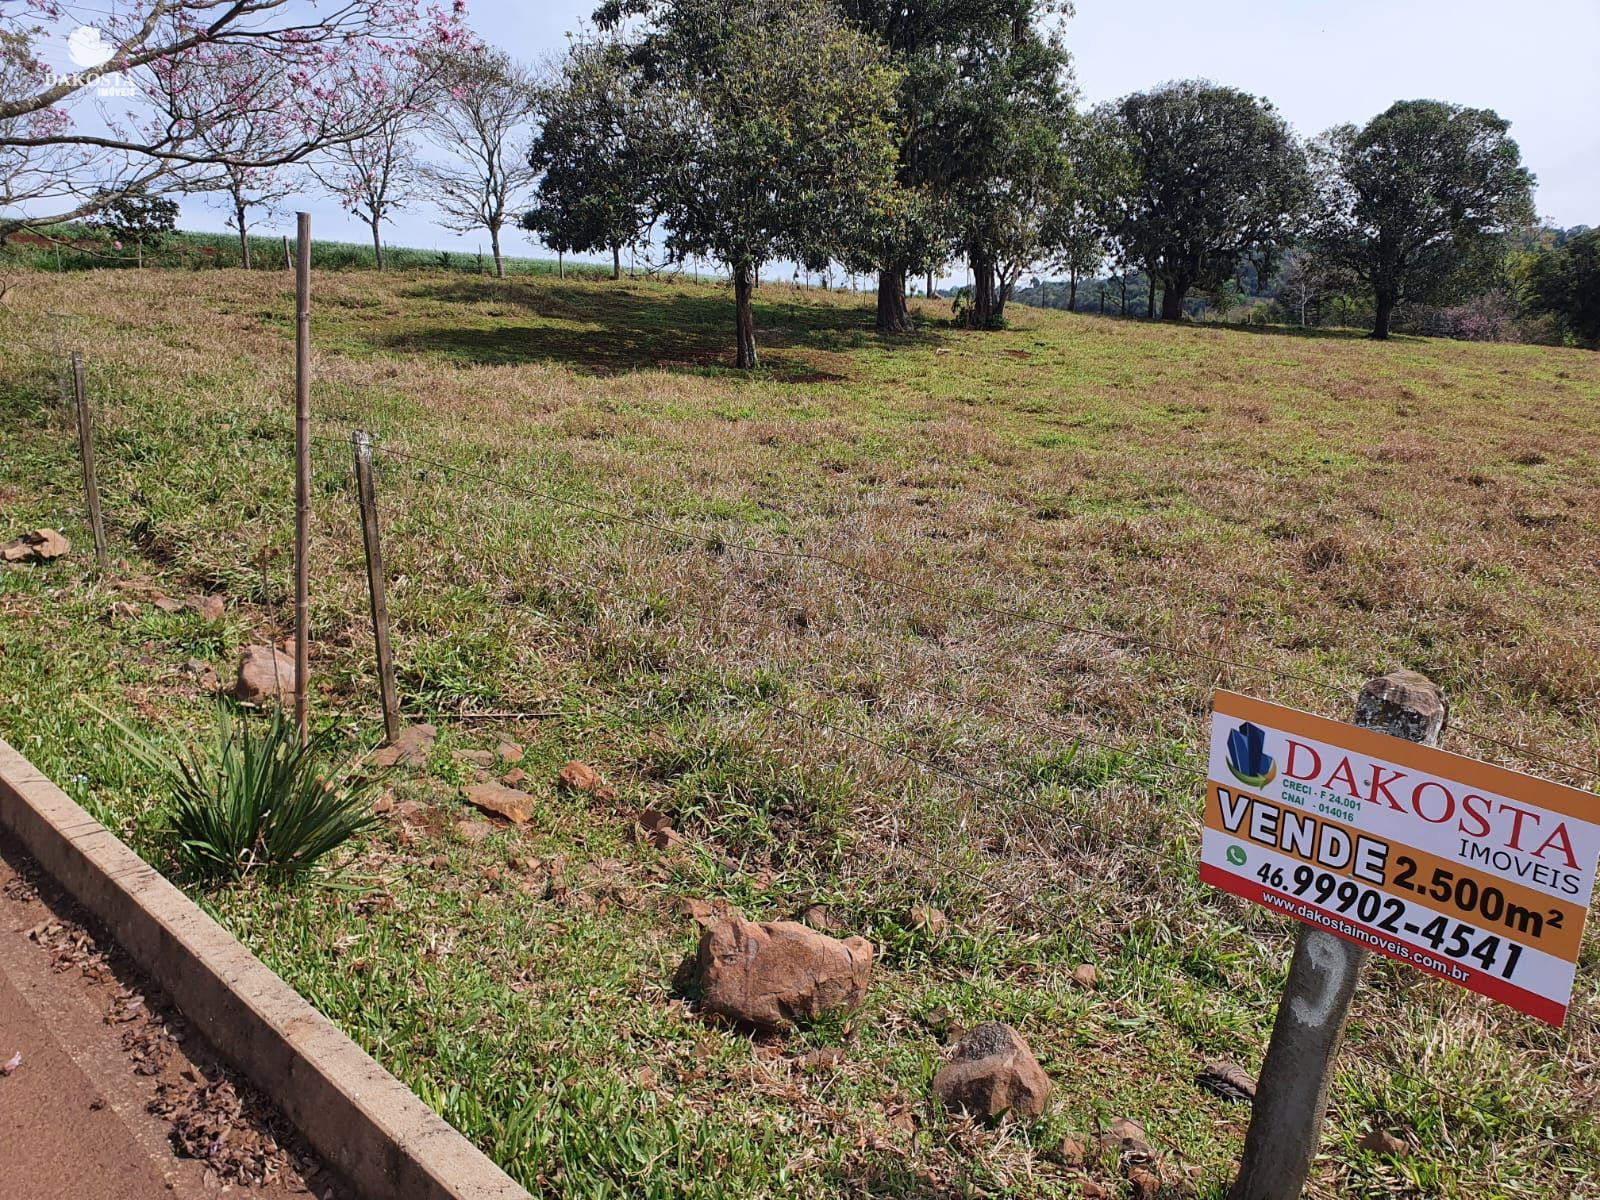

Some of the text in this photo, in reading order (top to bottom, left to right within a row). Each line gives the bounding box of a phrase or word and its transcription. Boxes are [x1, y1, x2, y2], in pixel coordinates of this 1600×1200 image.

[1217, 788, 1389, 886] VENDE
[1281, 791, 1305, 806] CNAI
[1318, 803, 1354, 822] 014016
[1282, 778, 1312, 796] CRECI
[1320, 791, 1327, 799] F
[1328, 793, 1361, 811] 24.001
[1282, 739, 1583, 872] DAKOSTA
[1458, 838, 1580, 895] IMOVEIS
[1256, 862, 1523, 980] 46.99902-4541
[1262, 890, 1470, 983] www.dakostaimoveis.com.br
